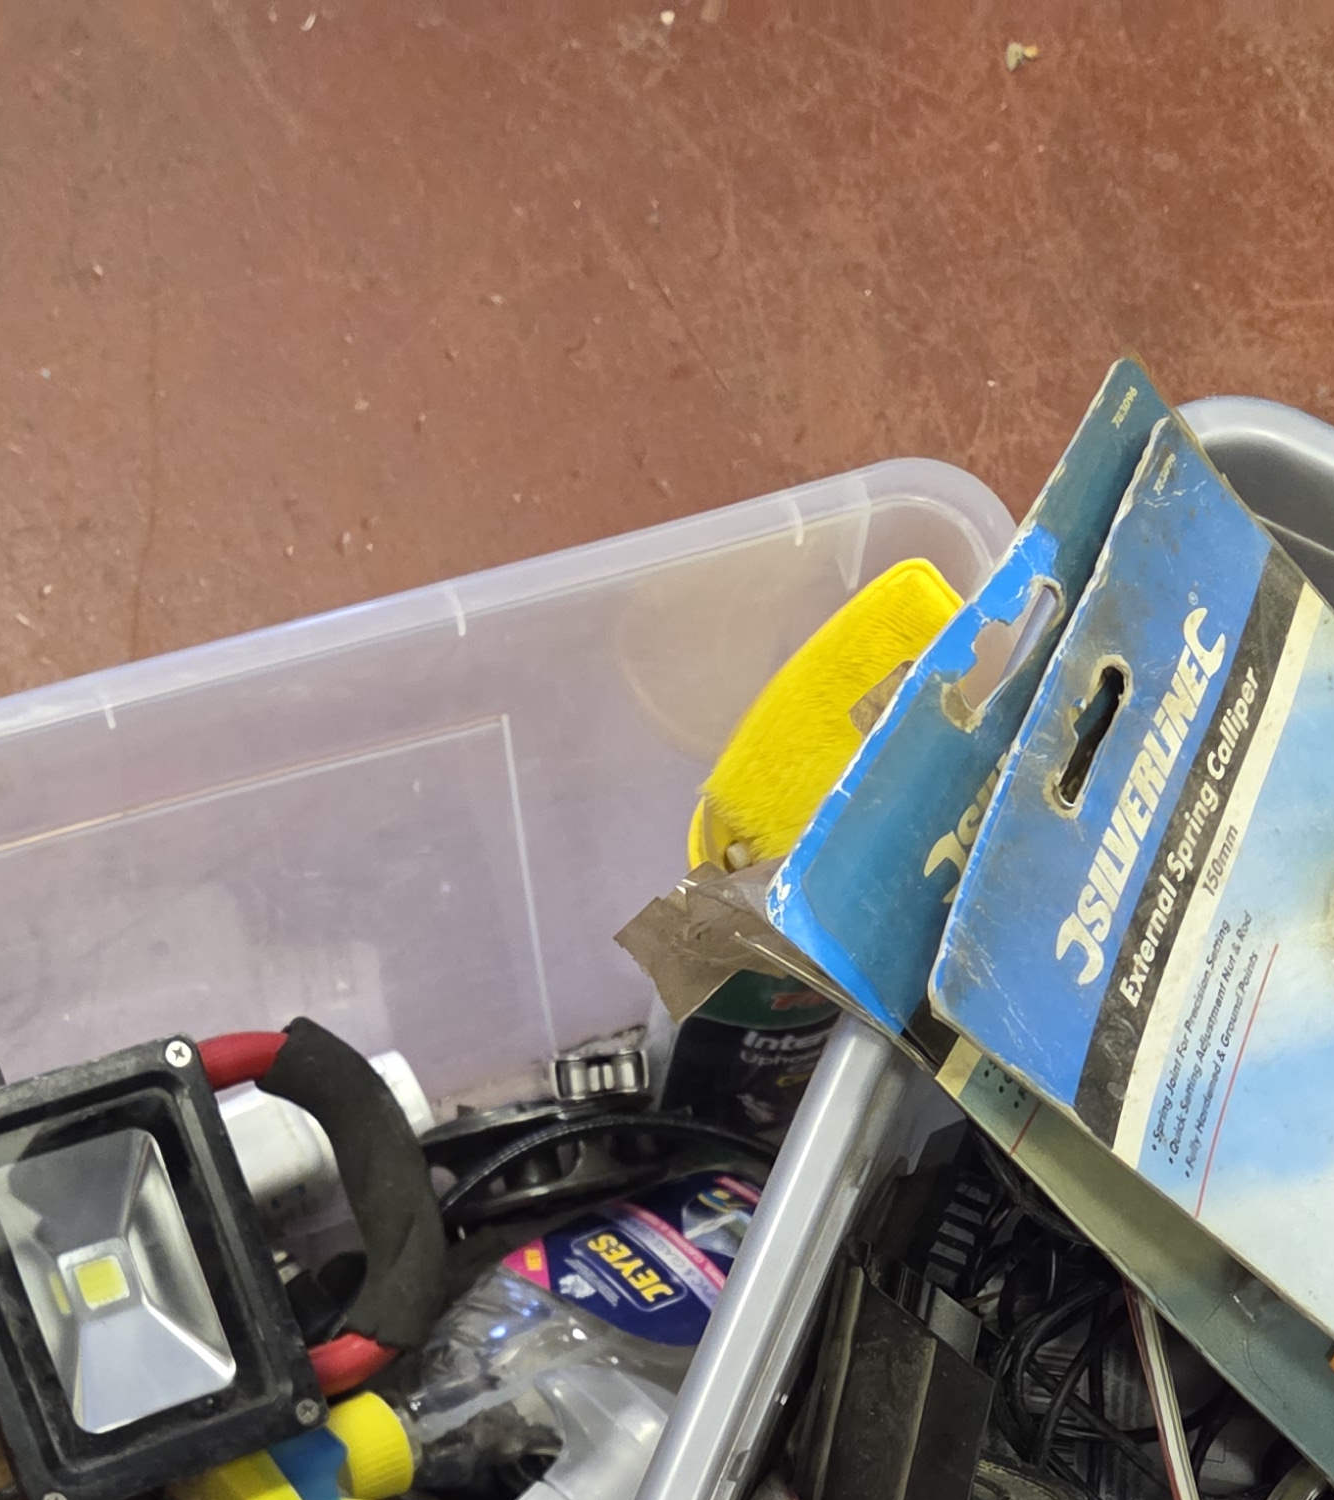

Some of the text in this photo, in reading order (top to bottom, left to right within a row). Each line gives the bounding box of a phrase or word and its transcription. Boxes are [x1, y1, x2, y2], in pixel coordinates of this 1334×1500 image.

[1118, 666, 1260, 1008] External Spring Calliper
[1201, 824, 1239, 897] 150mm
[1152, 919, 1231, 1143] Spring Joint For Precision Setting
[1169, 909, 1253, 1155] Quick Setting Adjustment Nut & Rod
[1185, 950, 1259, 1170] Fully Hardened & Ground Points
[587, 1234, 674, 1303] JEYES
